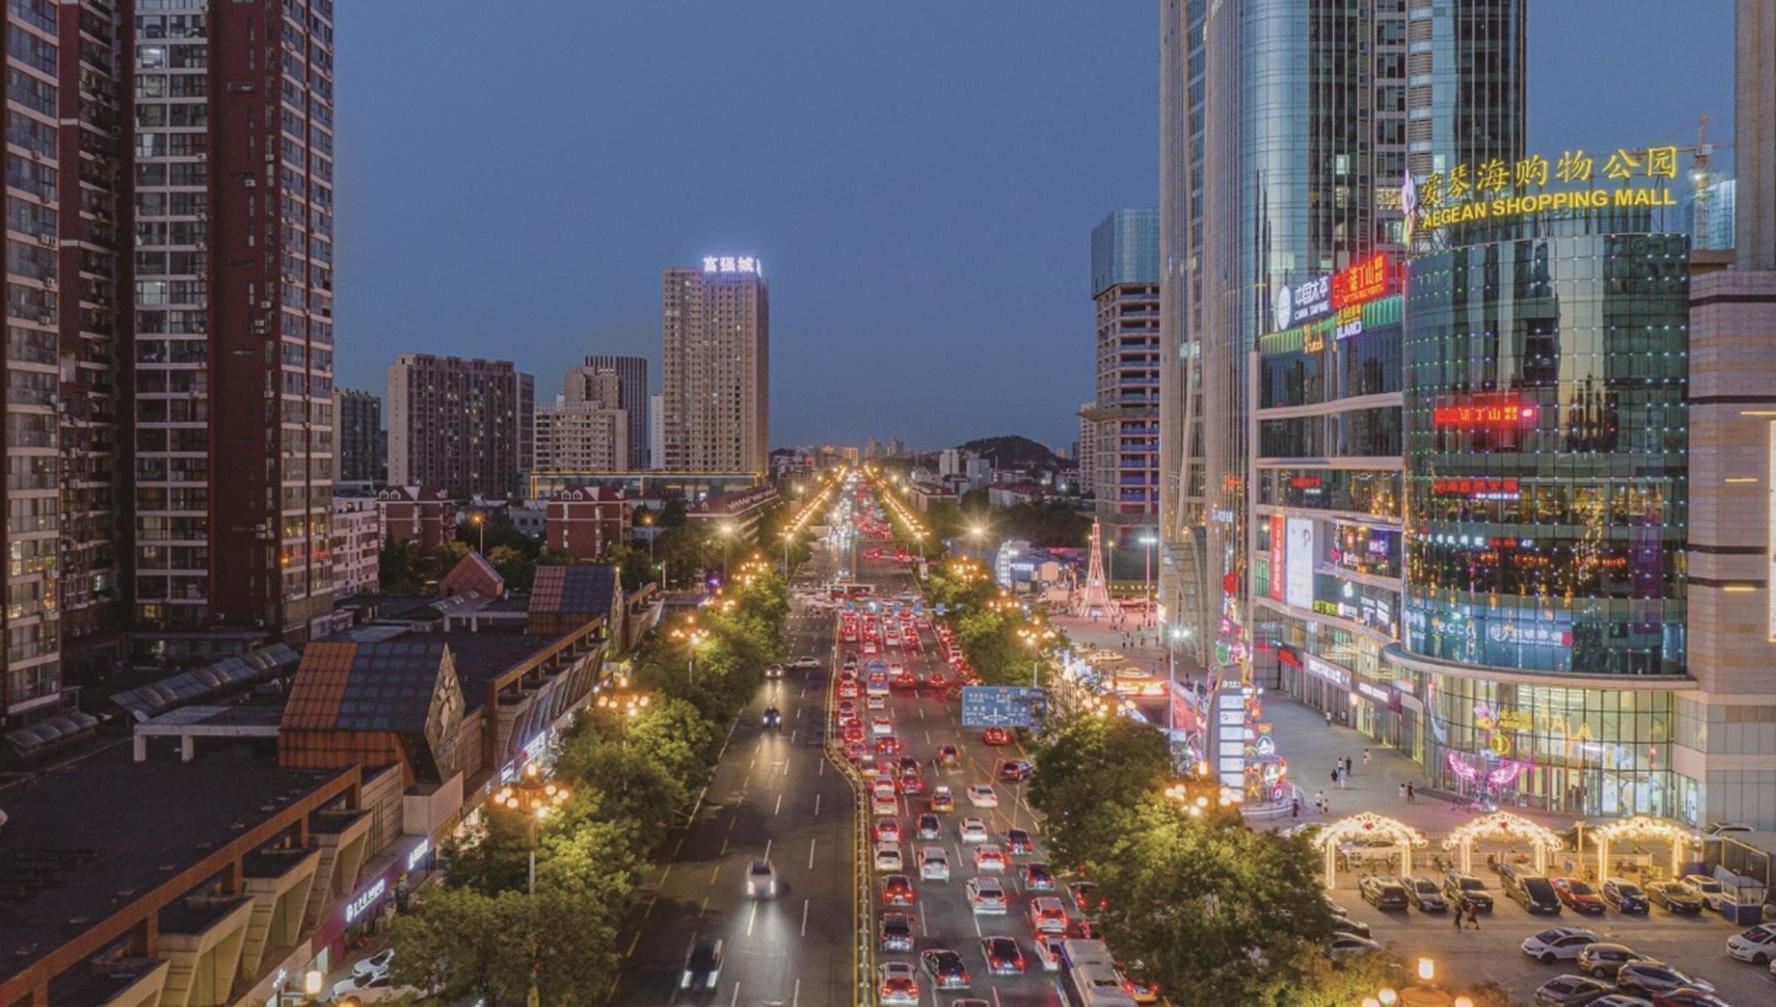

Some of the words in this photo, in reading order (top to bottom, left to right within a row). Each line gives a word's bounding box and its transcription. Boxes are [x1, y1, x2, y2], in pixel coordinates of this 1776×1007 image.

[1422, 146, 1678, 208] 爱琴海购物公园
[1423, 203, 1487, 230] AEGEAN
[1492, 189, 1608, 216] SHOPPING
[1615, 187, 1677, 206] MALL
[1295, 275, 1329, 307] 中国太平
